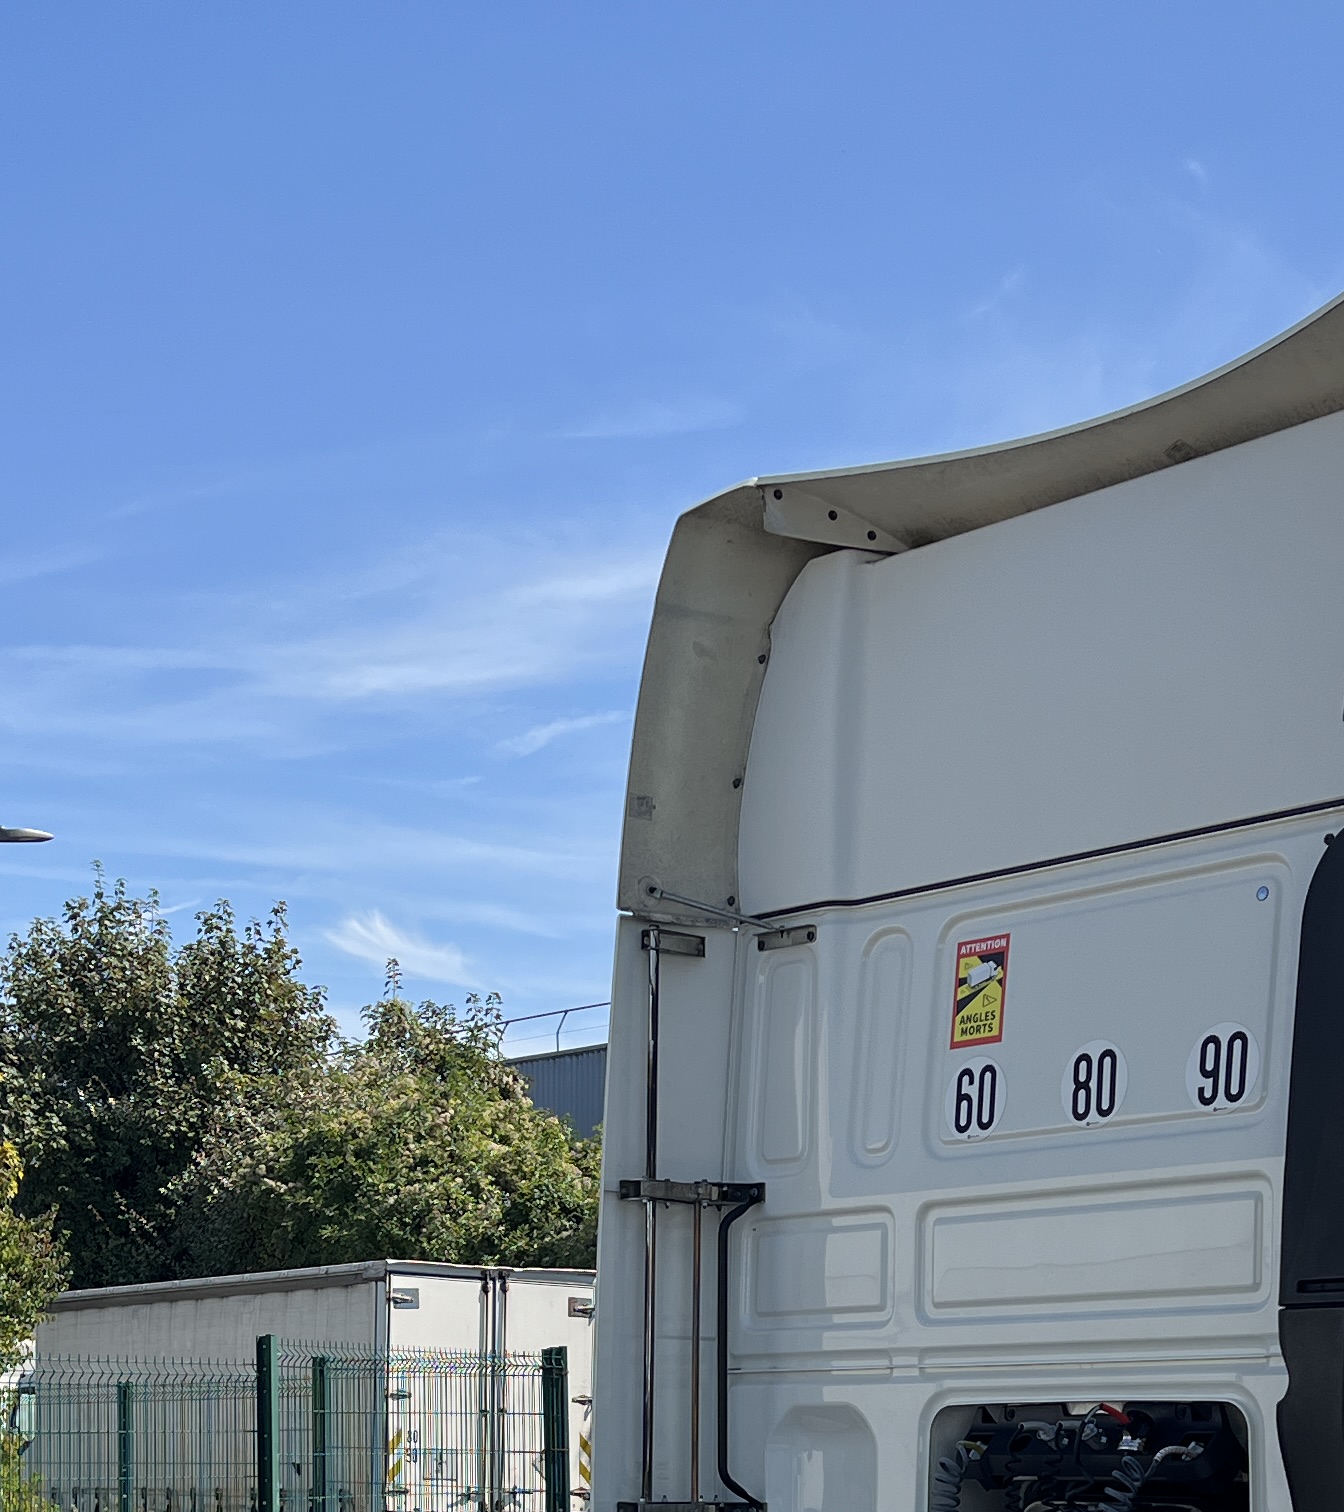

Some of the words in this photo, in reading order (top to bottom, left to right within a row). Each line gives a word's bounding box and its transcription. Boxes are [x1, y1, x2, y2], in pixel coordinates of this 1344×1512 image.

[960, 938, 1007, 955] ATTENTION
[959, 1010, 996, 1025] ANGLES
[960, 1022, 994, 1037] MORTS
[1071, 1048, 1117, 1122] 80
[1197, 1030, 1249, 1107] 90
[954, 1064, 997, 1134] 60
